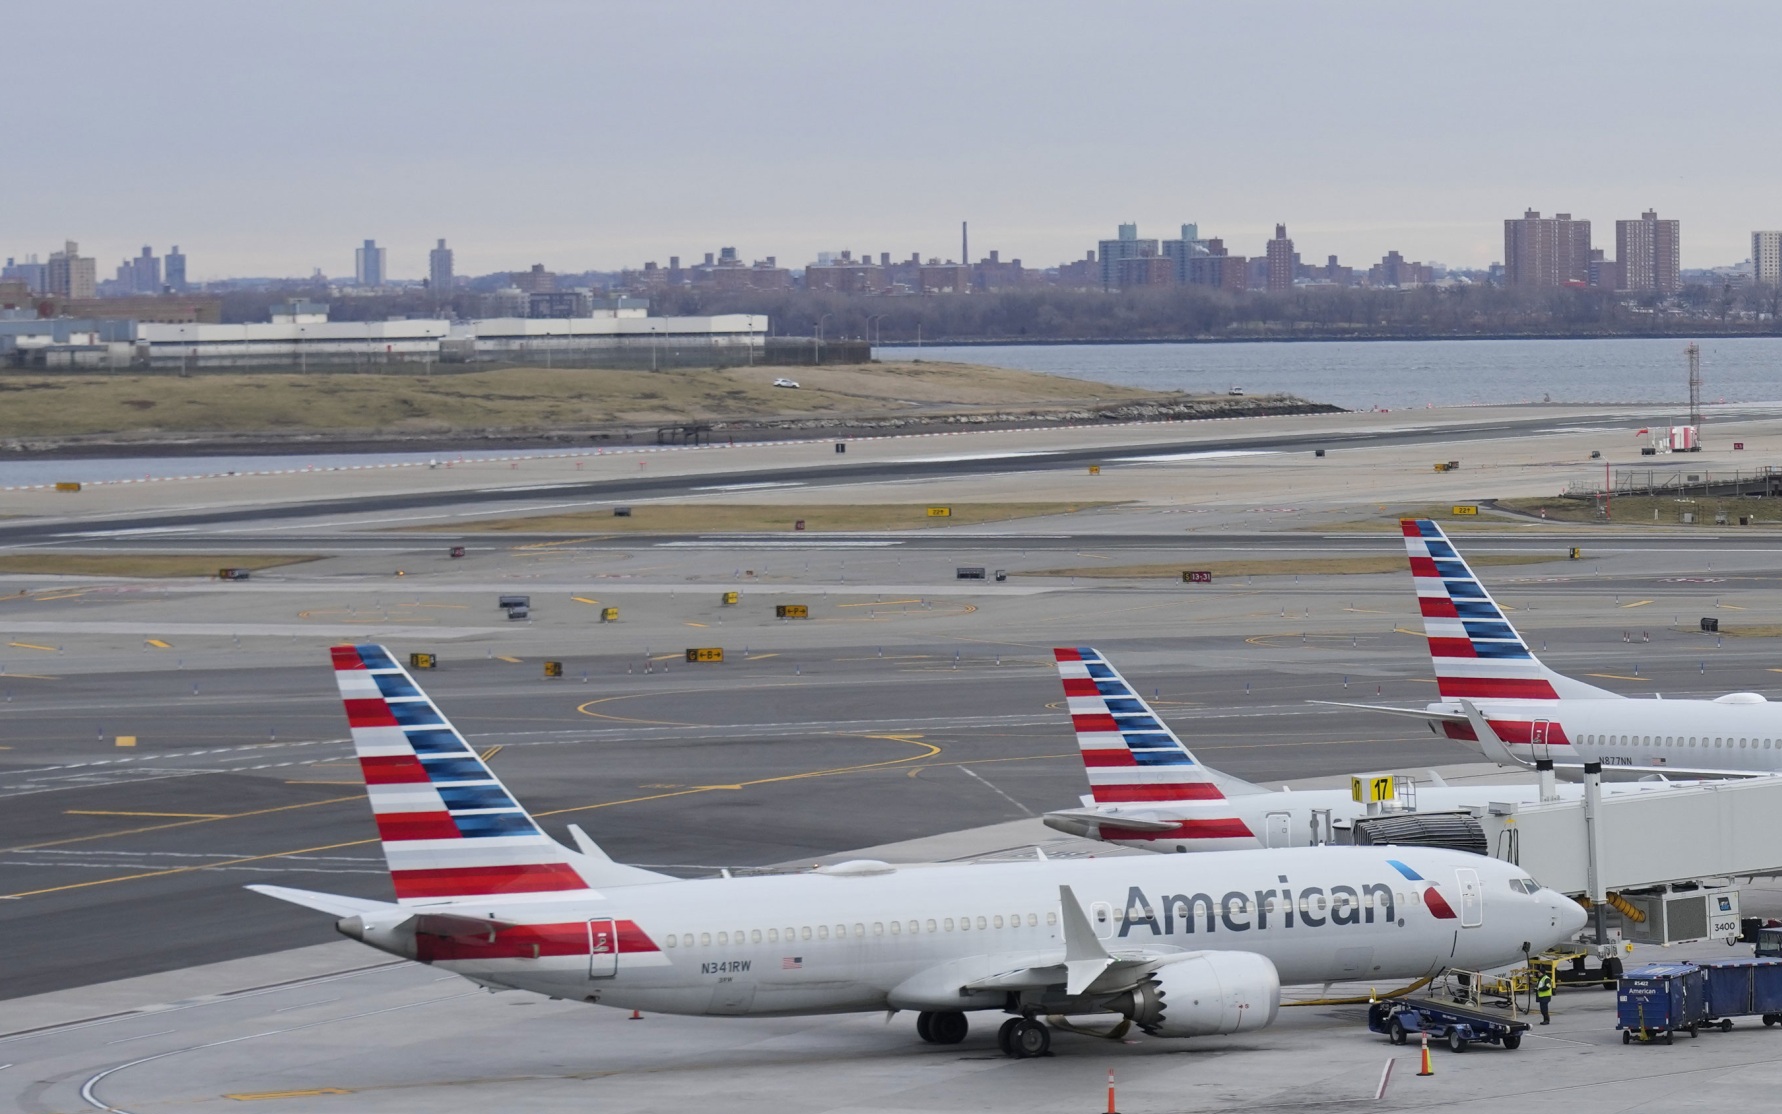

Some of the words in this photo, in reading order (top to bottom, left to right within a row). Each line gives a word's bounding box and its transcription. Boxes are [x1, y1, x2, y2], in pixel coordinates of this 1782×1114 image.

[1598, 755, 1633, 767] N877NN
[1374, 778, 1388, 800] 17
[1117, 875, 1395, 938] American
[1714, 920, 1736, 932] 3400
[701, 959, 752, 975] N341RW
